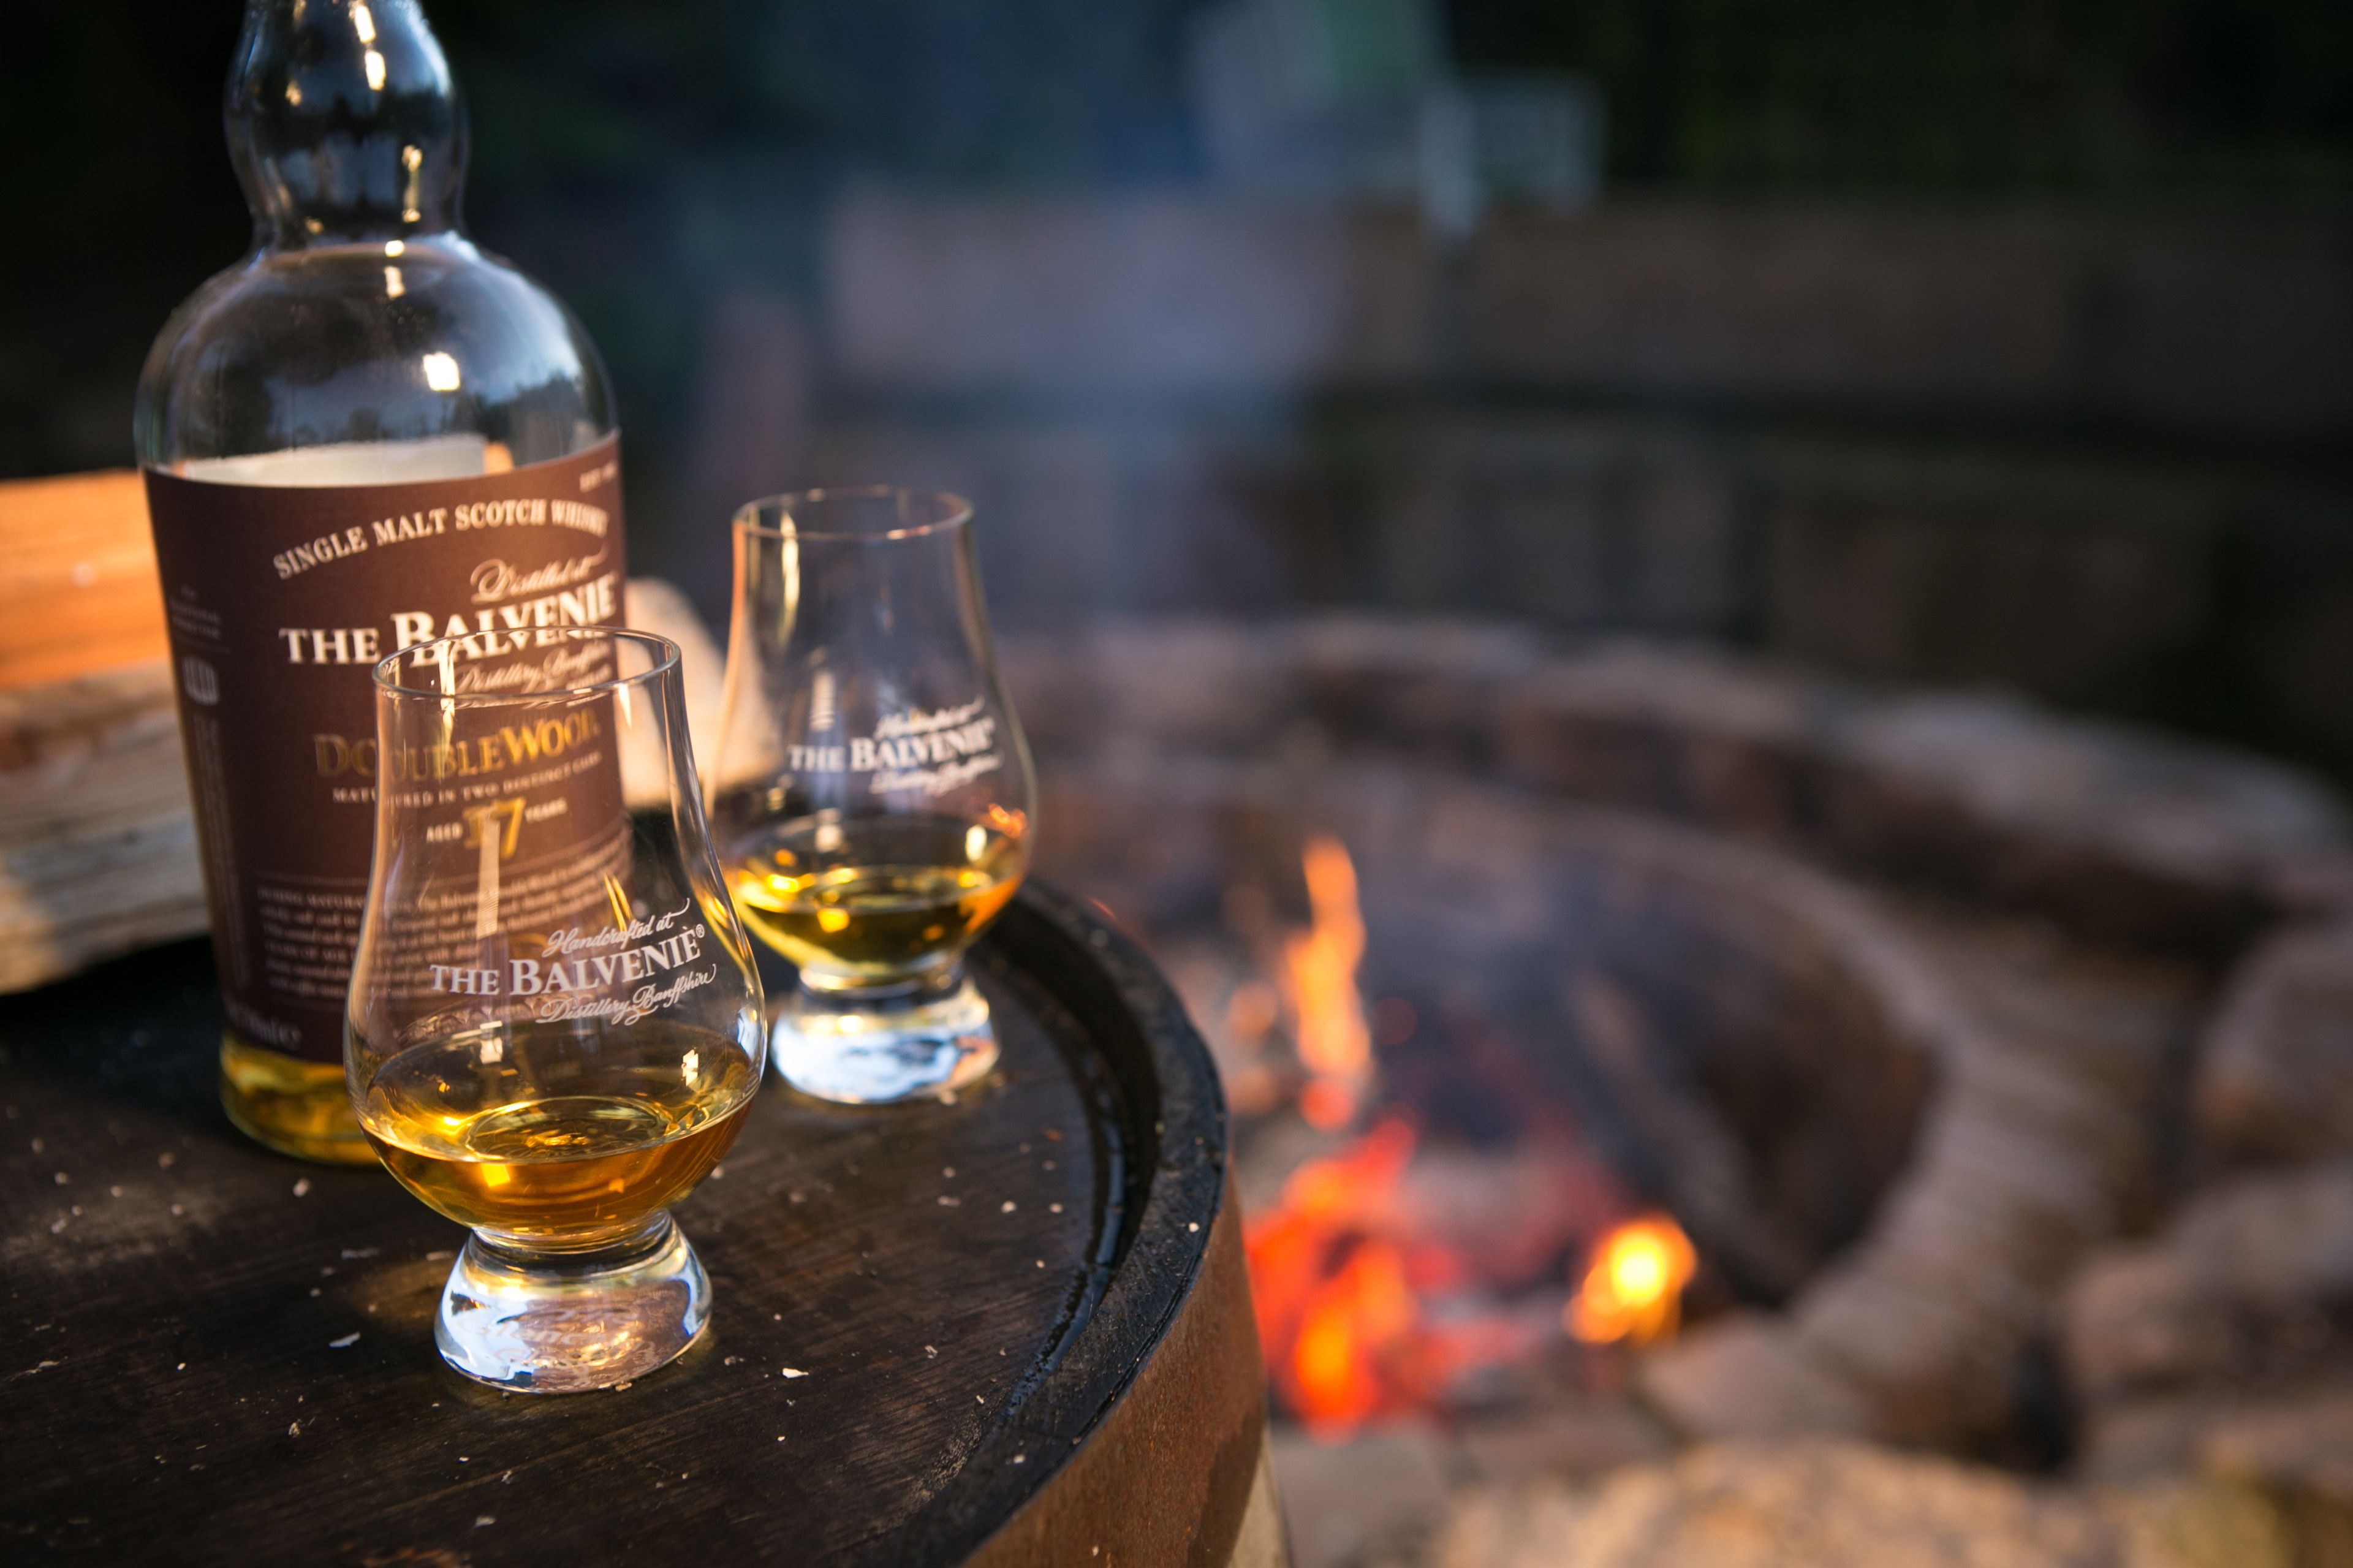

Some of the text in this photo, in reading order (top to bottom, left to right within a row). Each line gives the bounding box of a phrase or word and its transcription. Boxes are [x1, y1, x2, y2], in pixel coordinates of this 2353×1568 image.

[273, 526, 368, 580] SINGLE
[371, 507, 448, 546] MALT
[455, 498, 548, 531] SCOTCH
[279, 570, 617, 668] THE BALVENIE
[788, 744, 845, 772] THE
[462, 795, 527, 857] 17
[540, 915, 654, 957] Handcrafted
[429, 963, 500, 996] THE
